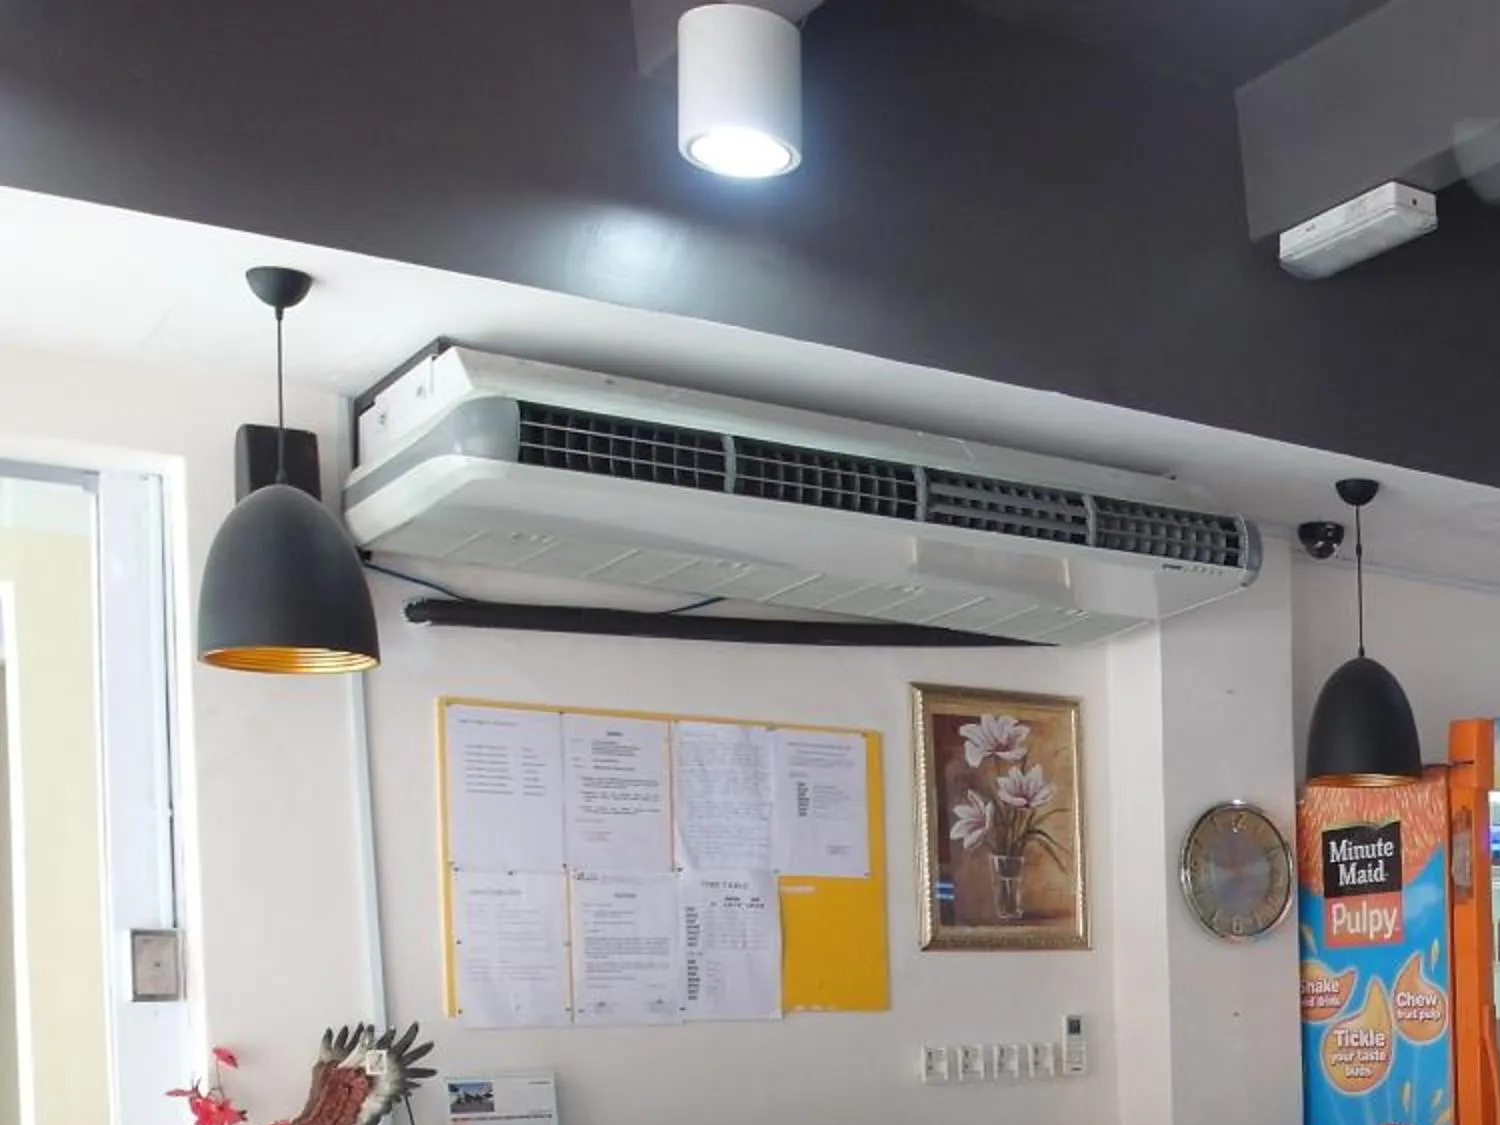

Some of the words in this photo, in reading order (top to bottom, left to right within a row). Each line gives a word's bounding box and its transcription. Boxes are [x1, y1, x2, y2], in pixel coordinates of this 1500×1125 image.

[1328, 838, 1394, 863] Minute
[1338, 859, 1387, 887] Maid
[1331, 900, 1398, 941] Pulpy
[1396, 991, 1438, 1008] Chew
[1333, 1028, 1386, 1048] Tickle
